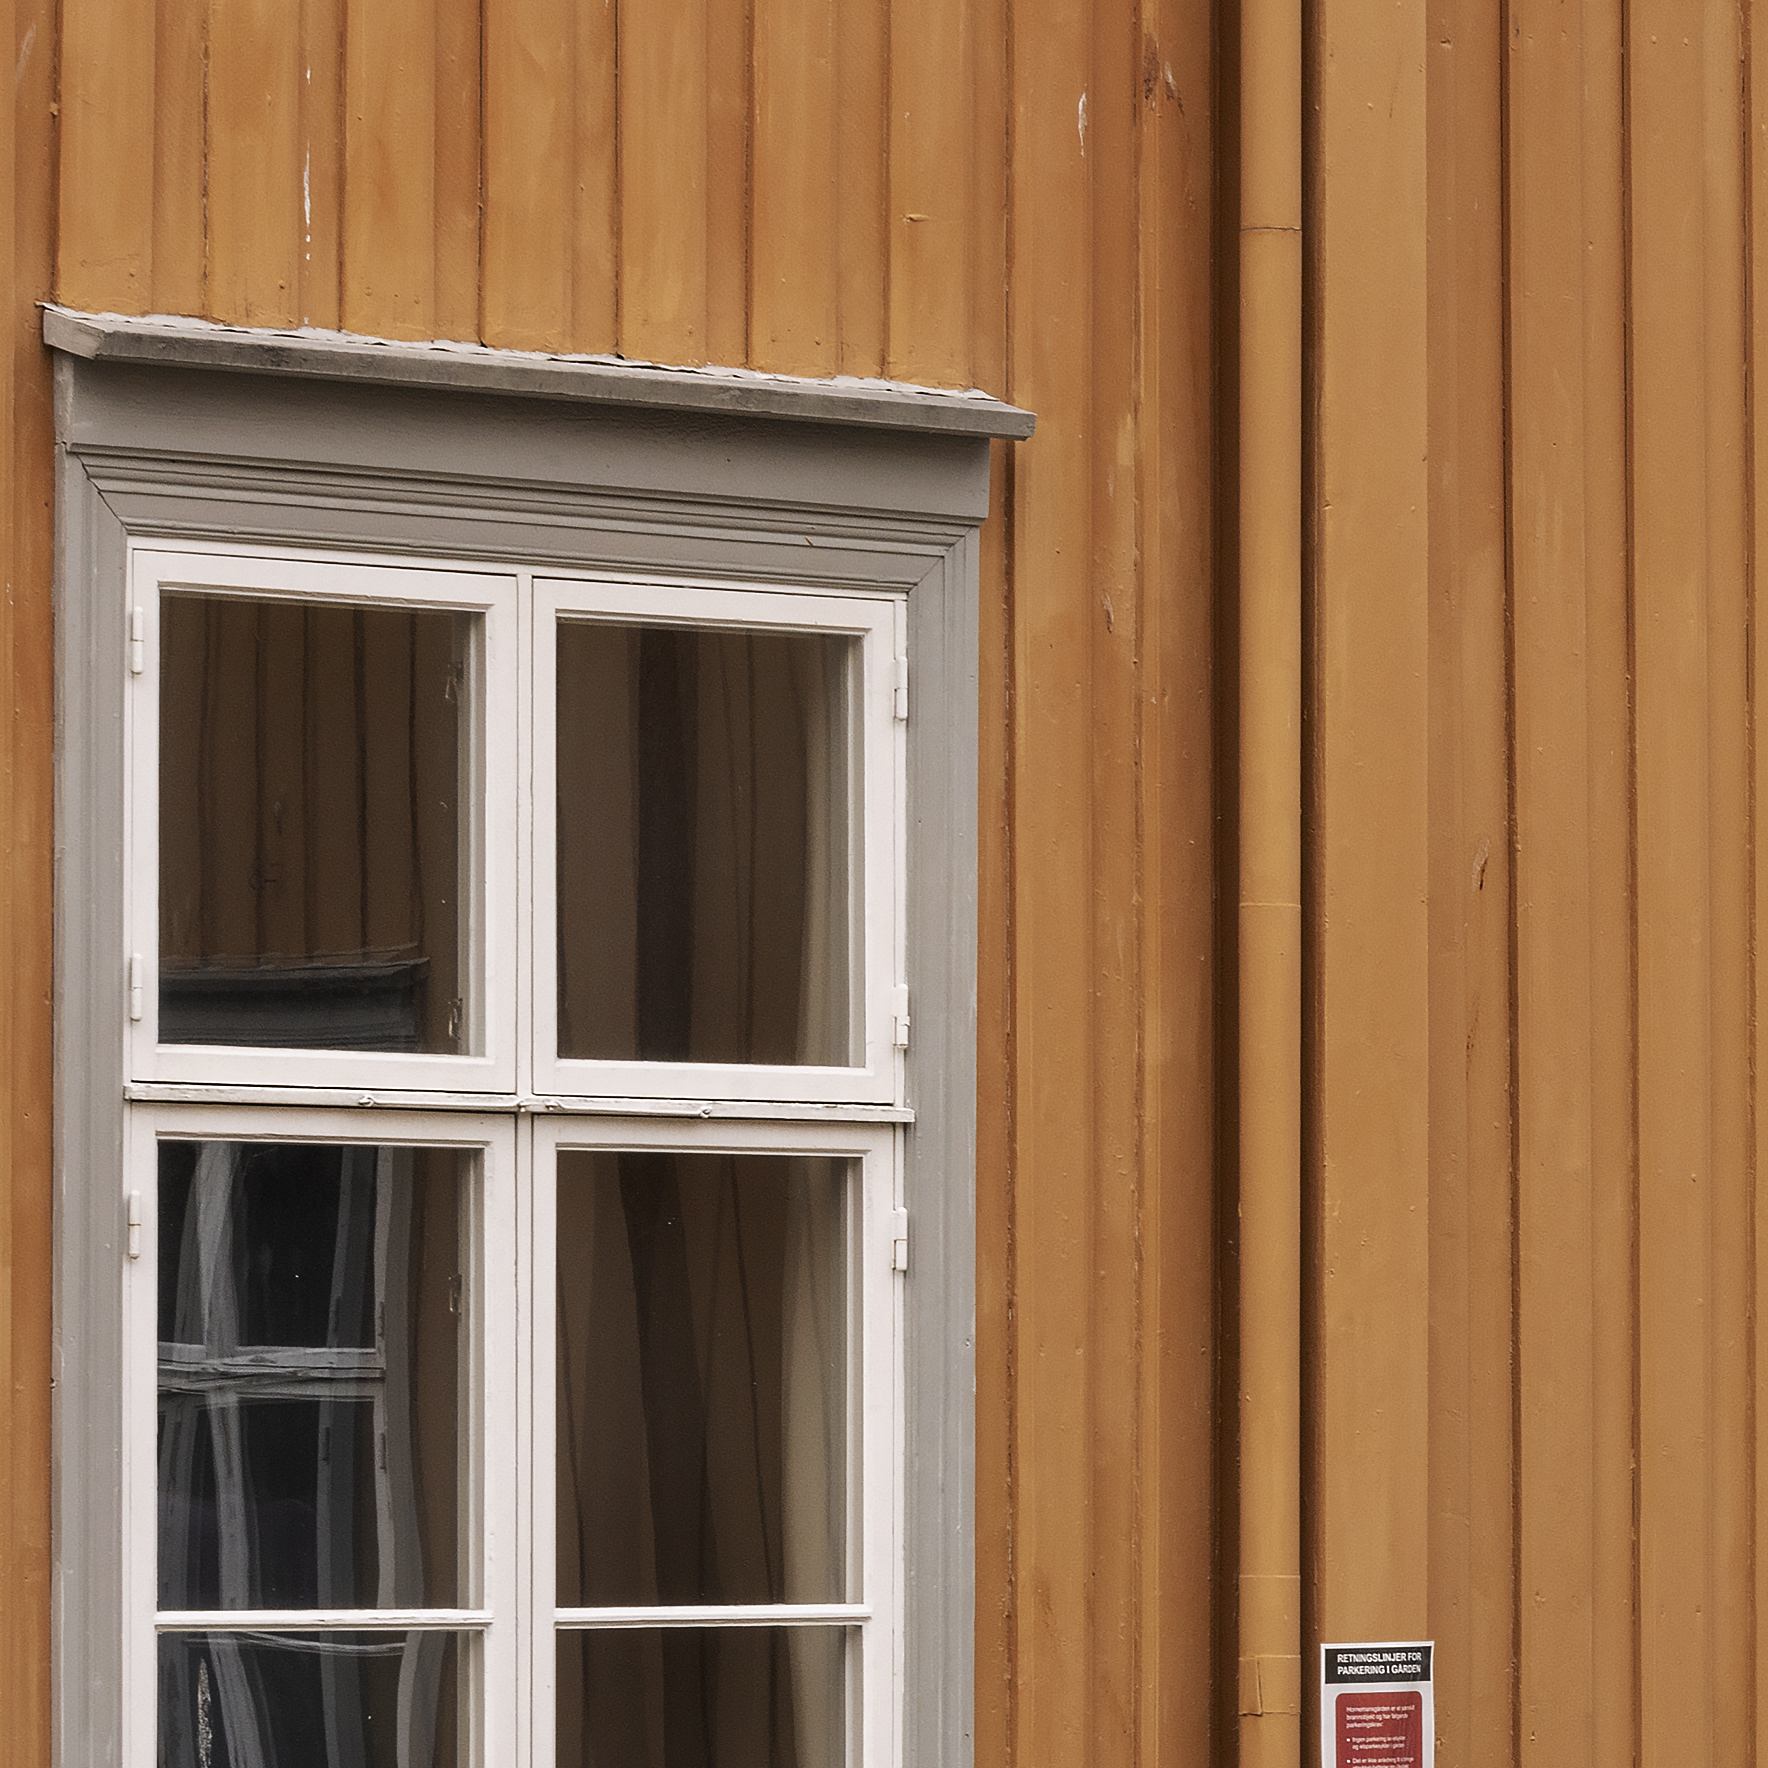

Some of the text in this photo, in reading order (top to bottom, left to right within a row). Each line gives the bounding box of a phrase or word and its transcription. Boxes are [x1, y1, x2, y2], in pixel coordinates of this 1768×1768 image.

[1337, 1652, 1422, 1663] RETNINGSLINJER FOR
[1337, 1665, 1385, 1675] PARKERING
[1391, 1664, 1422, 1674] GÅRDEN
